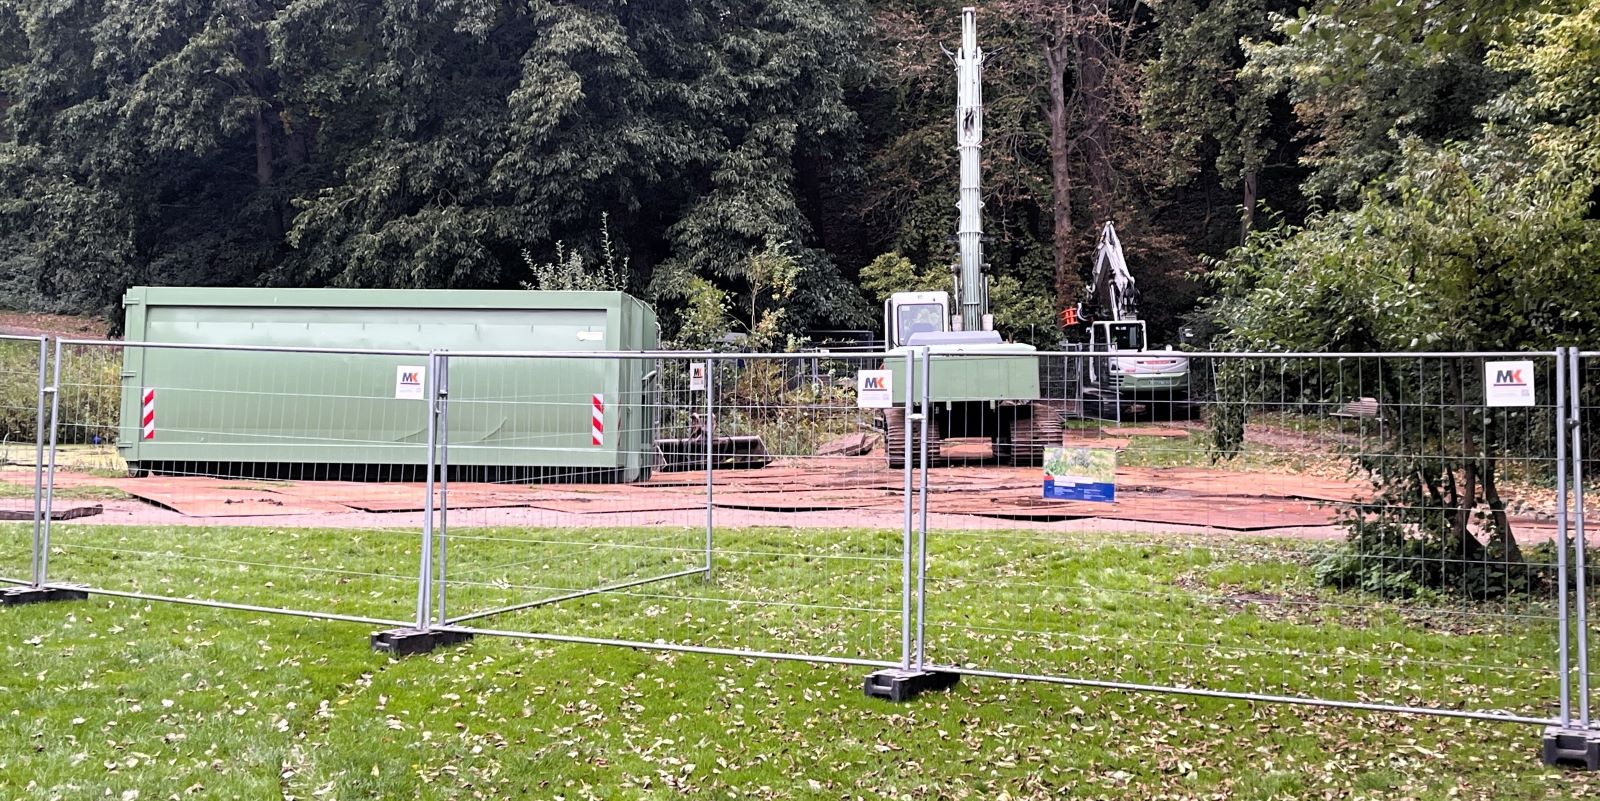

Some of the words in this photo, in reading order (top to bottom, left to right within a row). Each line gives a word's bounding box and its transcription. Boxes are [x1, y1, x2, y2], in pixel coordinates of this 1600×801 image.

[402, 372, 418, 382] MK
[1496, 369, 1523, 383] MK
[865, 377, 885, 388] MK
